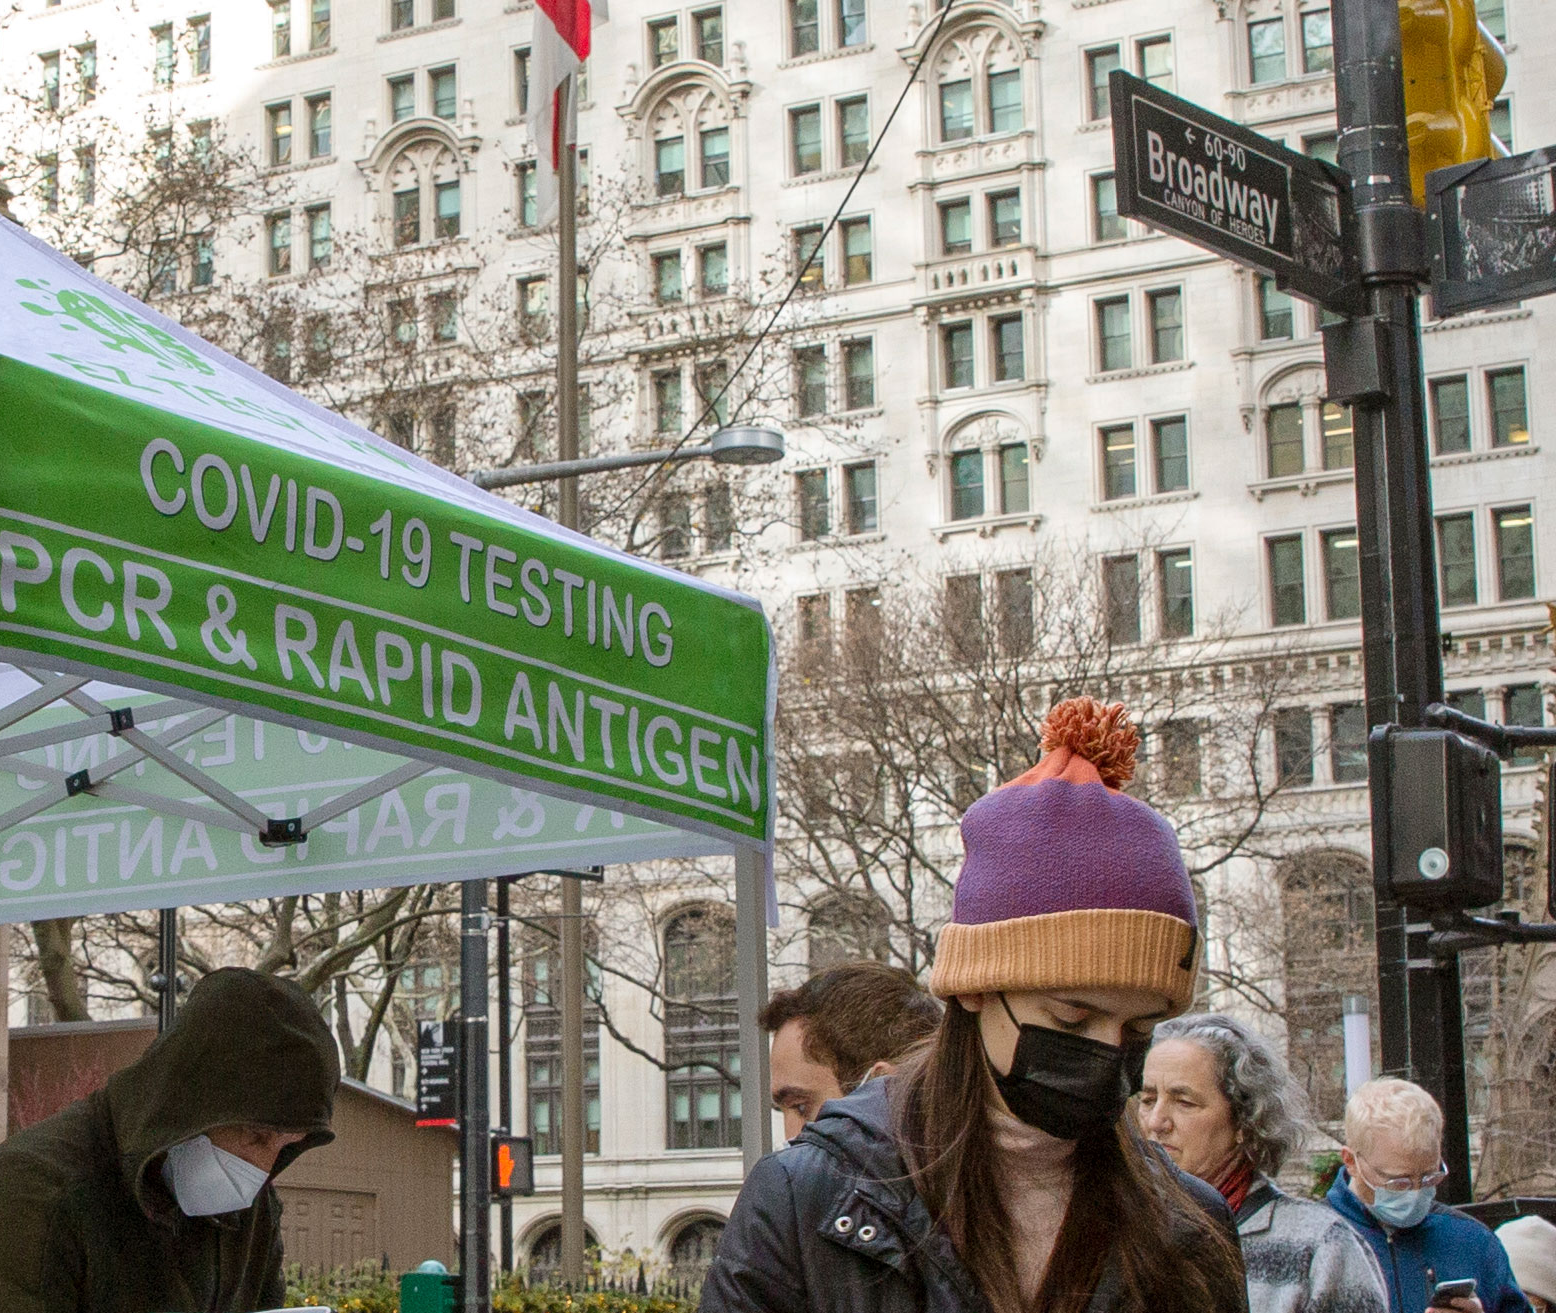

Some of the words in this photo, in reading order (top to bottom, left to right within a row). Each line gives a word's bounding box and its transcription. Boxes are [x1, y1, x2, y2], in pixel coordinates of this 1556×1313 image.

[1147, 129, 1278, 245] Broadway
[1204, 134, 1246, 171] 60-90
[1164, 188, 1205, 220] CANYON
[1211, 209, 1224, 226] OF
[1229, 216, 1266, 245] HEROES
[140, 437, 433, 589] COVID-19
[450, 531, 674, 668] TESTING
[201, 583, 257, 670] &
[275, 604, 482, 728] RAPID
[505, 672, 760, 813] ANTIGEN
